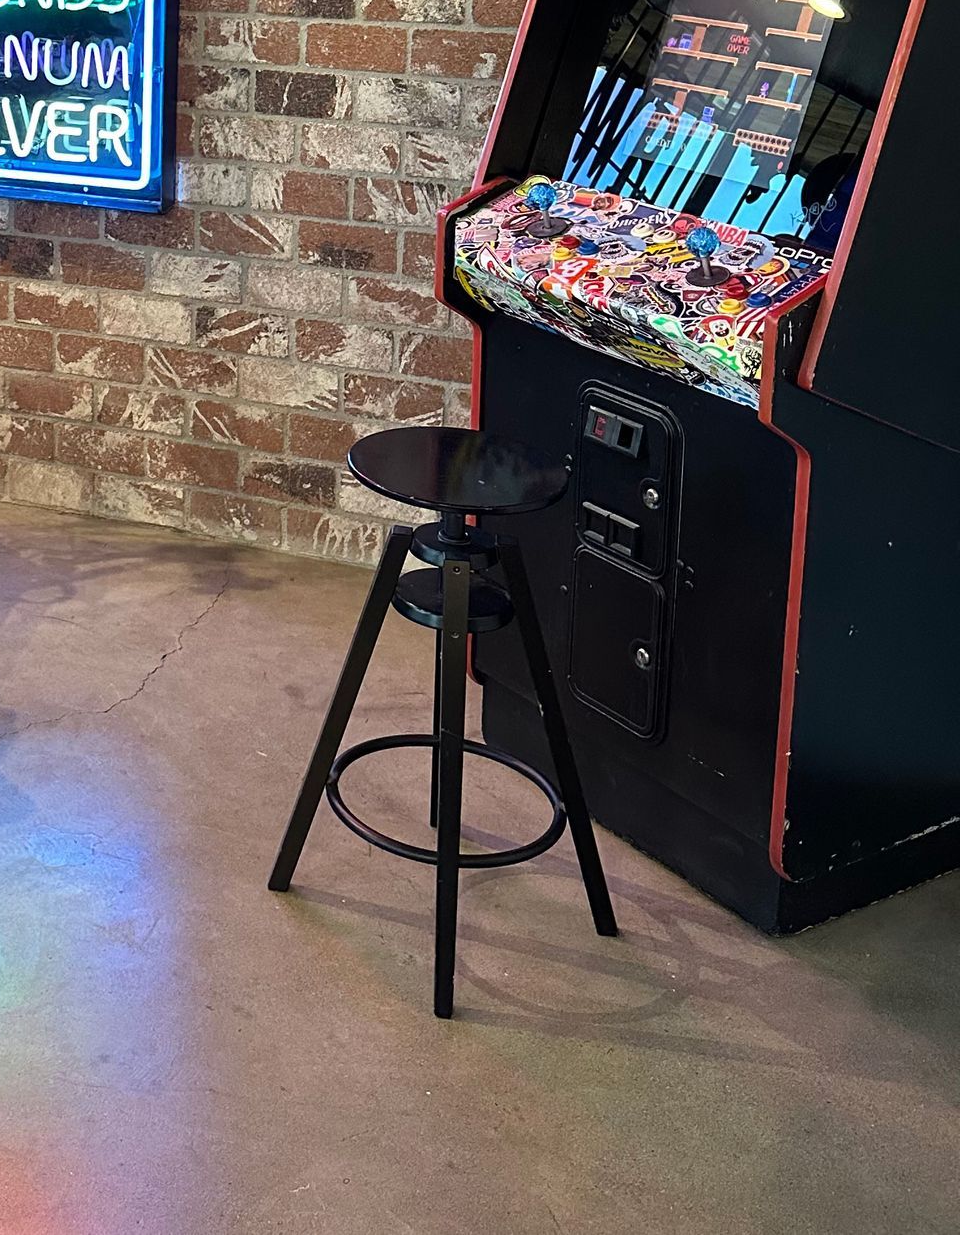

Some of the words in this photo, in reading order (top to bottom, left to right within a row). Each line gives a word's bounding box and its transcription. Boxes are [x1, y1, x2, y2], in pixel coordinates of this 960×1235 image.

[730, 34, 751, 45] GAME
[726, 43, 750, 54] OVER
[716, 224, 747, 247] NBA
